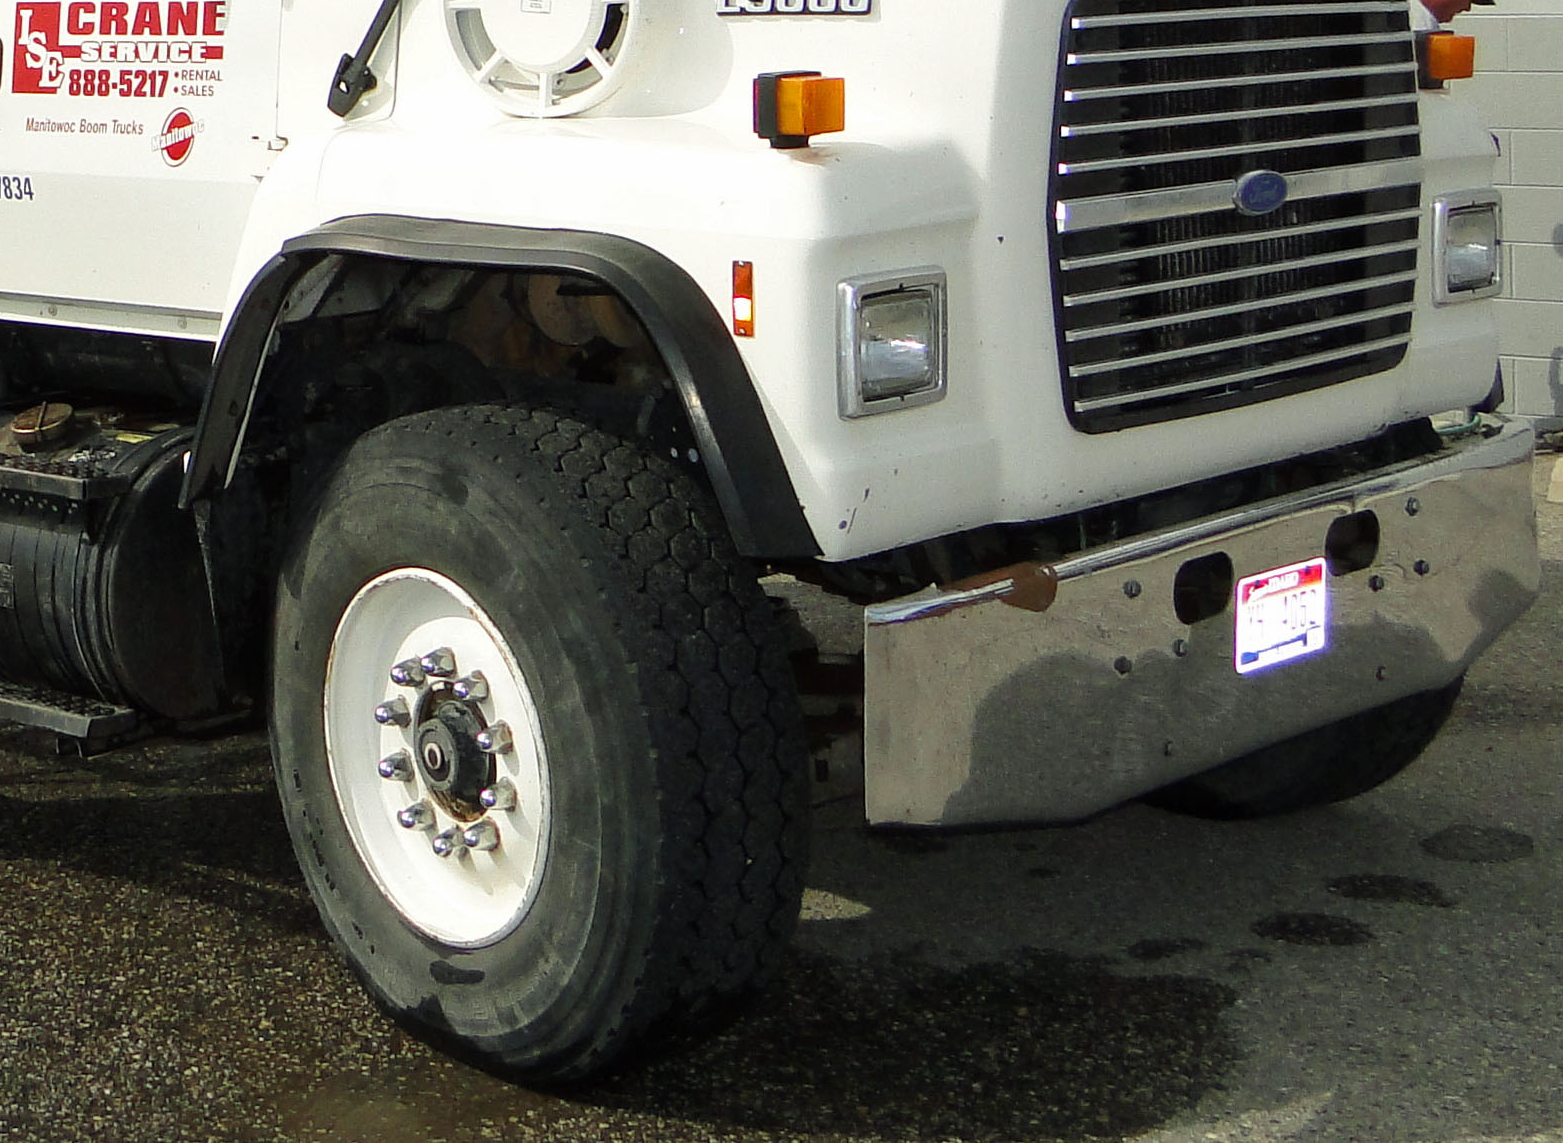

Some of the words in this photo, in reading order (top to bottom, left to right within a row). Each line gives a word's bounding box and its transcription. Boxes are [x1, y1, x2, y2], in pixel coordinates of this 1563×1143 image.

[67, 1, 226, 36] CRANE
[18, 9, 65, 88] ISE
[80, 41, 208, 63] SERVICE
[181, 69, 223, 82] RENTAL
[181, 85, 214, 97] SALES
[26, 117, 75, 134] Manitowoc
[79, 118, 107, 134] Boom
[111, 119, 144, 136] Trucks
